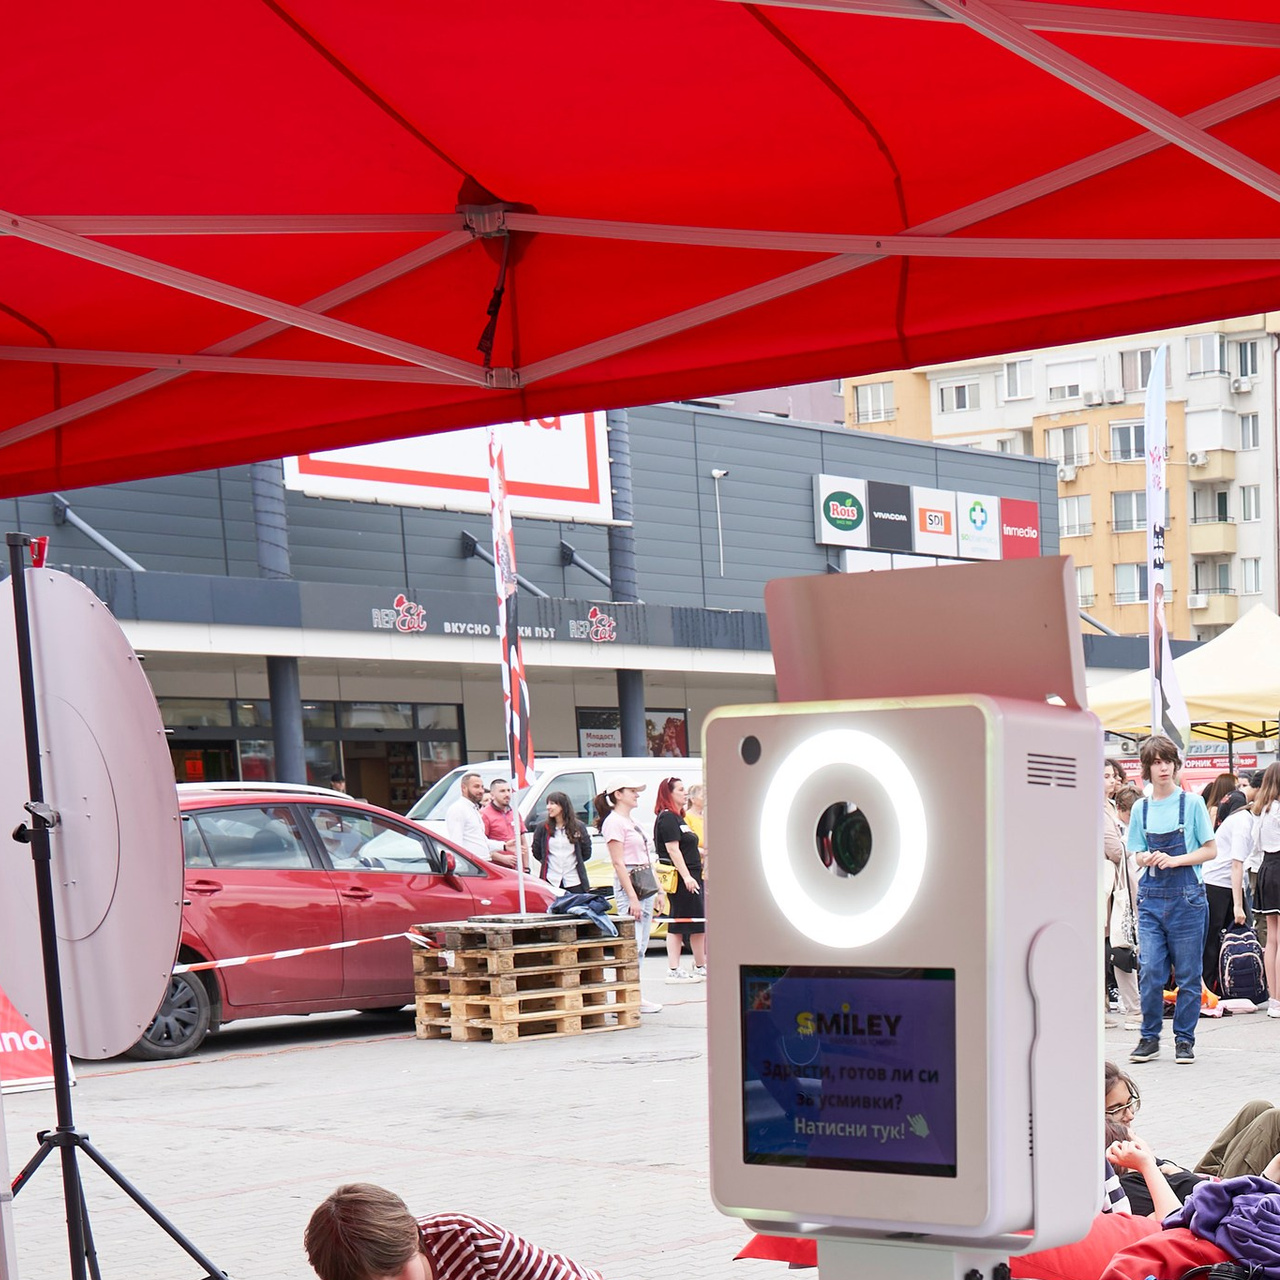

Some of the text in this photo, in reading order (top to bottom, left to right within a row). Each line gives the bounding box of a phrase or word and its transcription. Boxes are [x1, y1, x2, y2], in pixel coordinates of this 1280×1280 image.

[830, 502, 857, 520] Rois
[928, 513, 943, 527] SDI
[1003, 523, 1038, 539] inmedio
[443, 621, 491, 636] ВКУСНО
[762, 1060, 940, 1083] Здрасти, готов ли си
[819, 1093, 903, 1111] усмивки?
[794, 1117, 906, 1144] Натисни тук!
